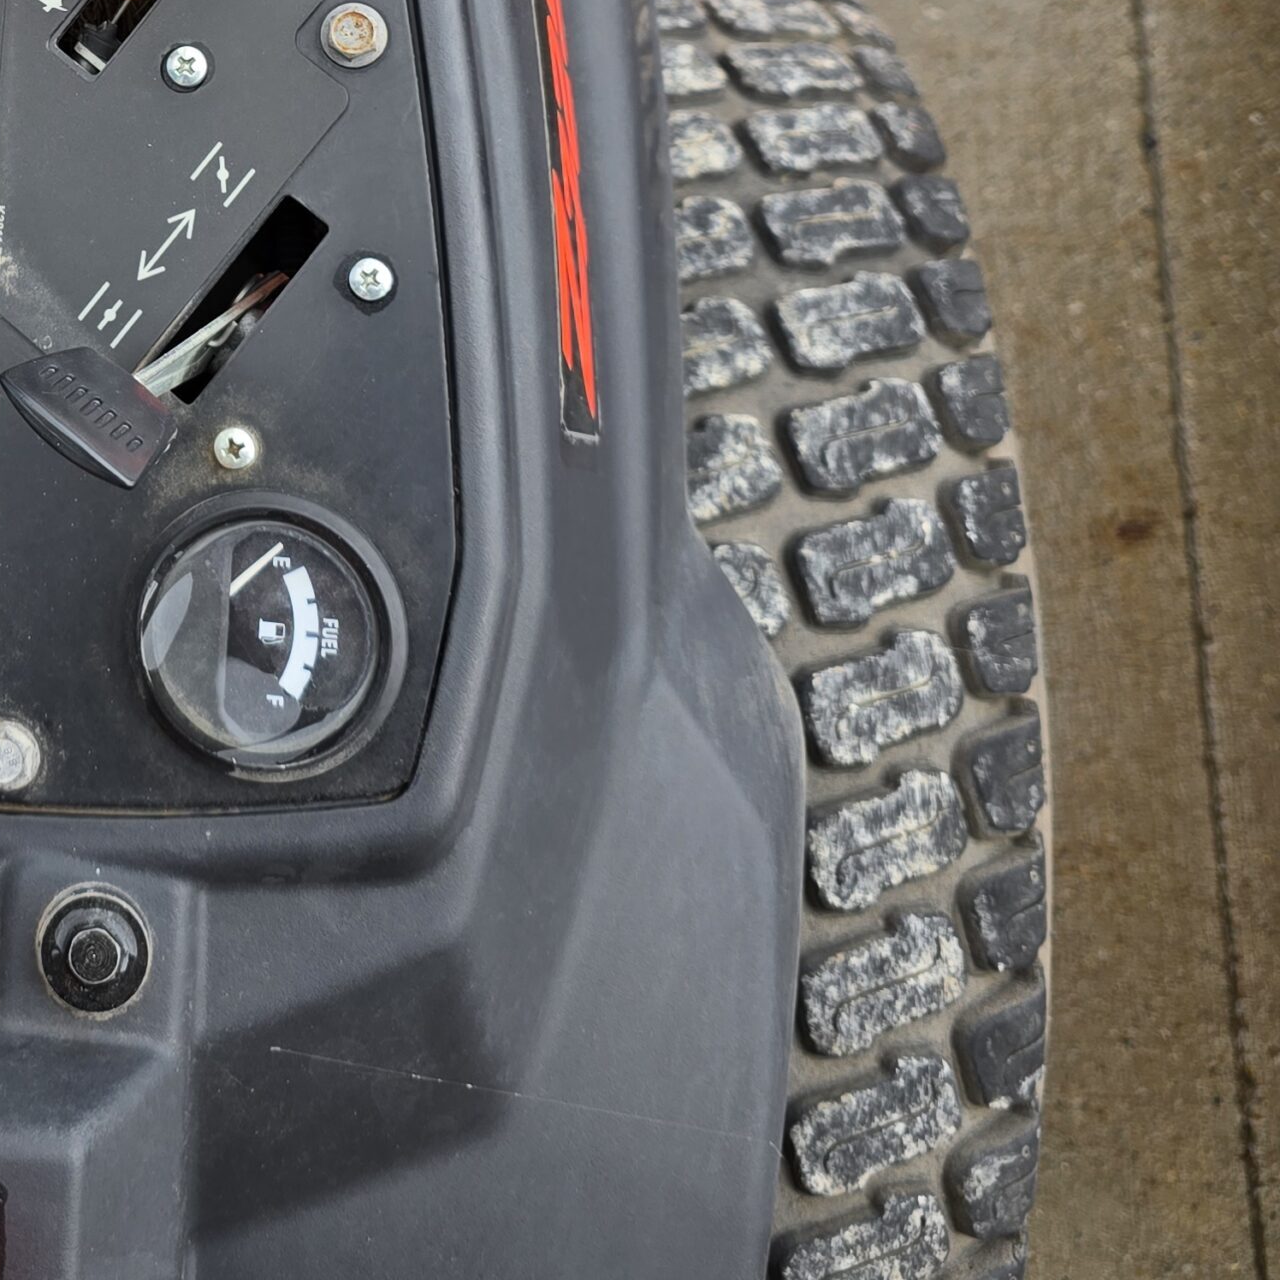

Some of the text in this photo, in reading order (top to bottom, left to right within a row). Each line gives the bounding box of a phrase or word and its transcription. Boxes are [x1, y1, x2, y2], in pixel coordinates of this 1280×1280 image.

[272, 555, 291, 569] E
[320, 616, 340, 658] FUEL
[265, 693, 285, 709] F
